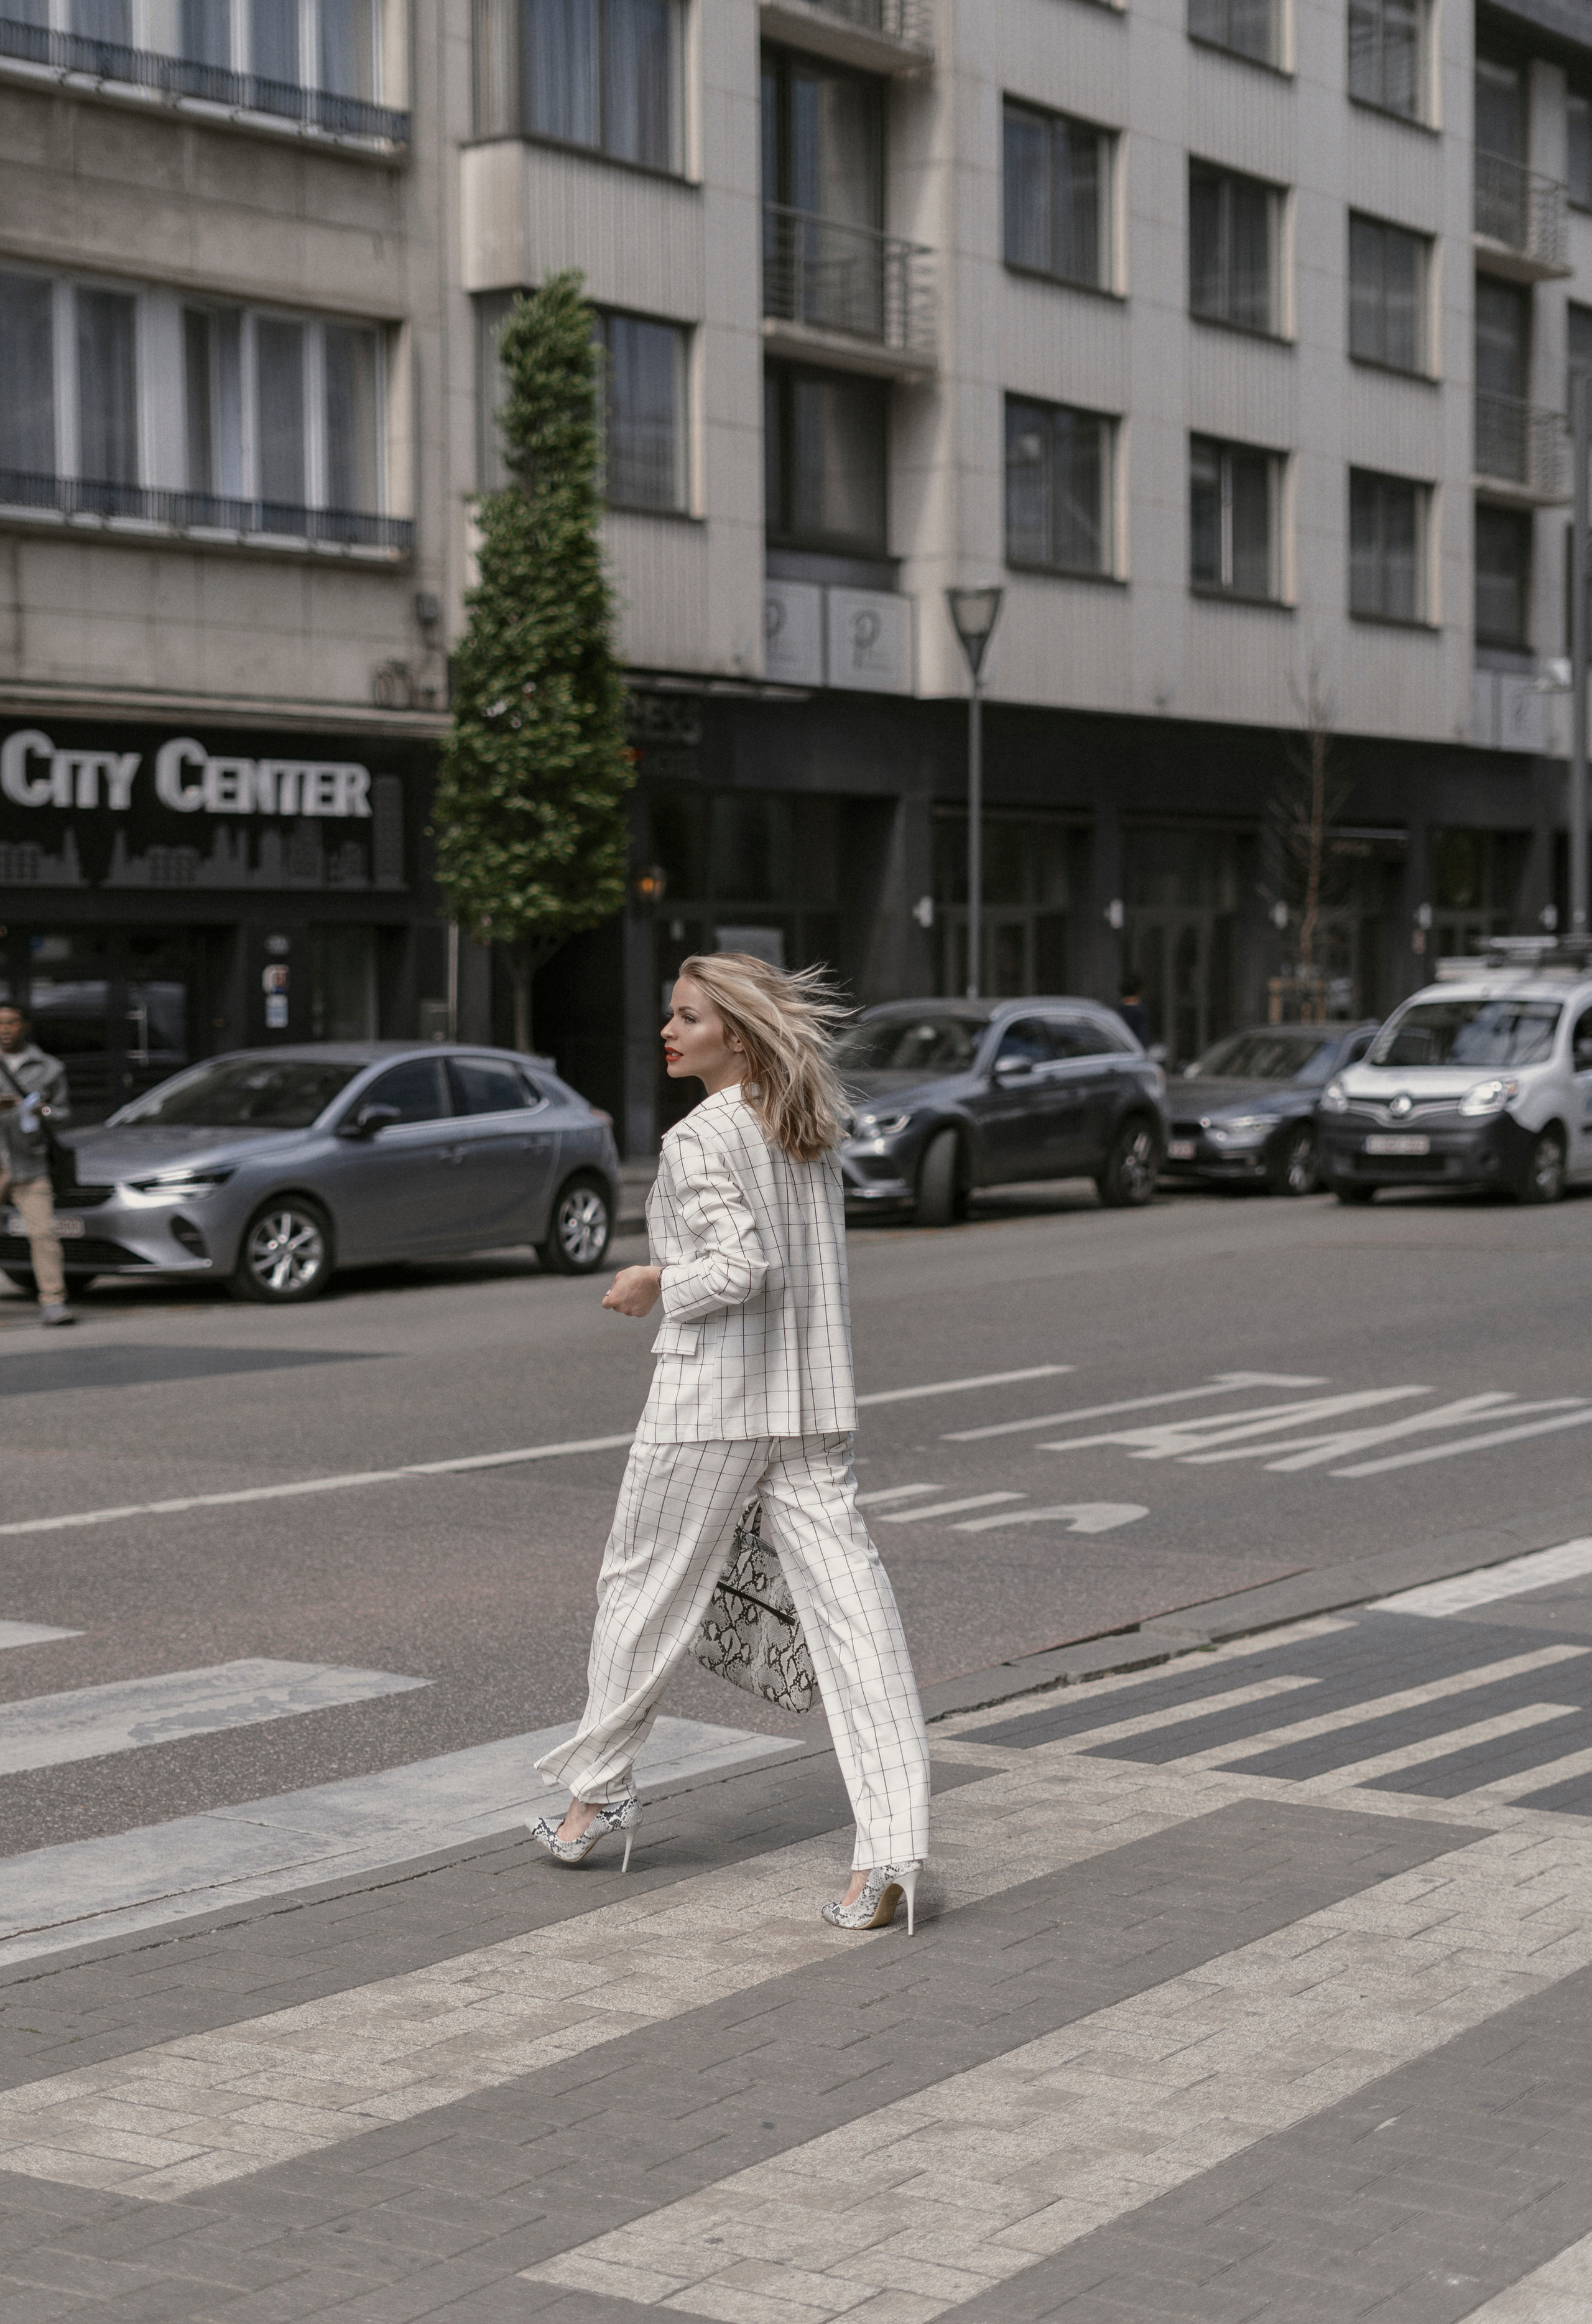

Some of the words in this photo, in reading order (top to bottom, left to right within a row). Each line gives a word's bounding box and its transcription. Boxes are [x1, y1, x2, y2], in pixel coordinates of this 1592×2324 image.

[0, 730, 142, 810] CITY
[155, 738, 372, 817] CENTER
[938, 1370, 1592, 1477] TAXI
